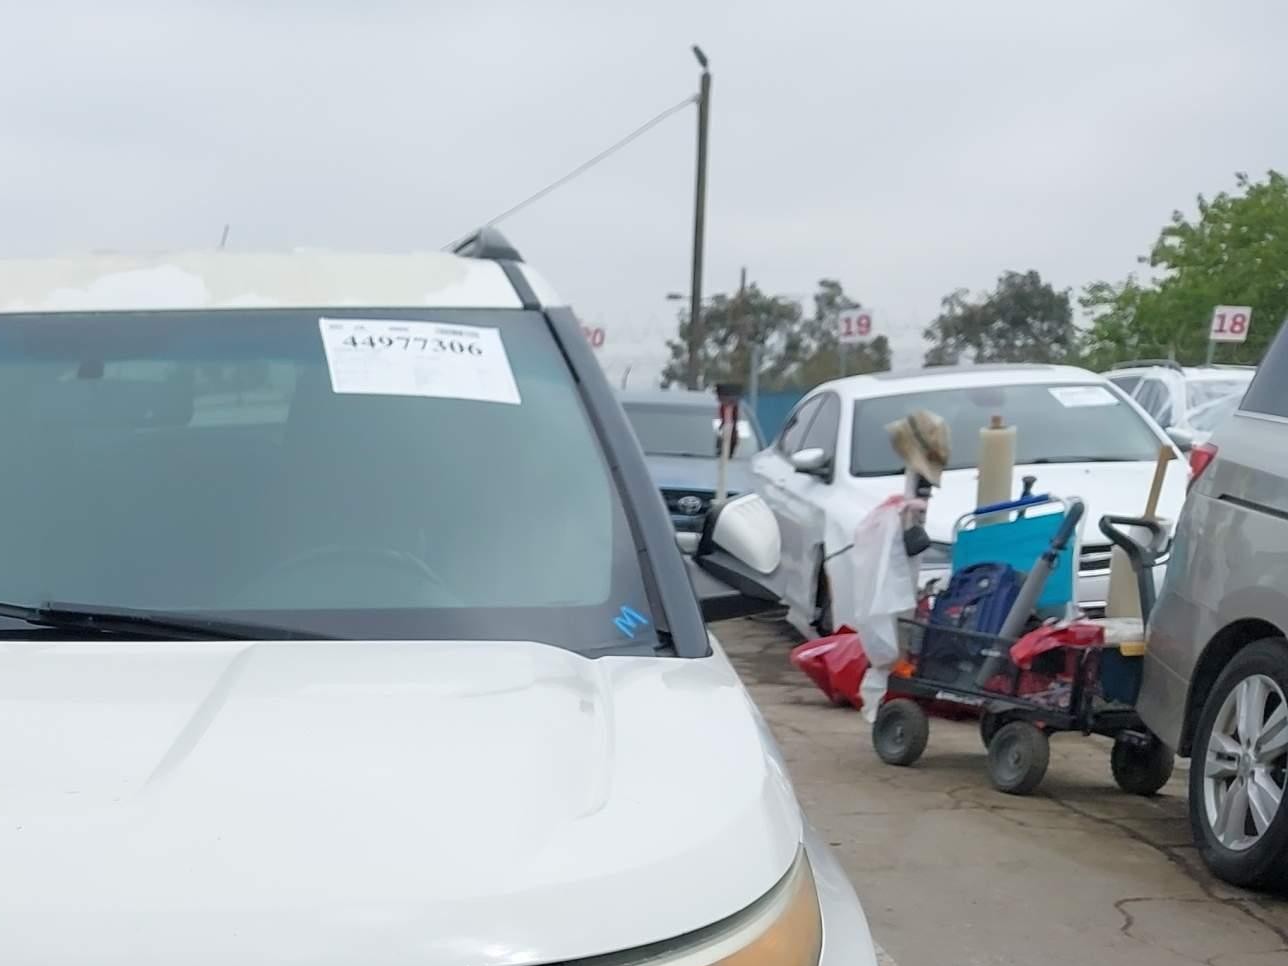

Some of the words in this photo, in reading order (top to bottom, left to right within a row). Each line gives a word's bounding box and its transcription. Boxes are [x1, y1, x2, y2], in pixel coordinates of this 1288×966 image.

[843, 314, 871, 337] 19
[1213, 313, 1247, 334] 18
[342, 334, 483, 356] 44977306
